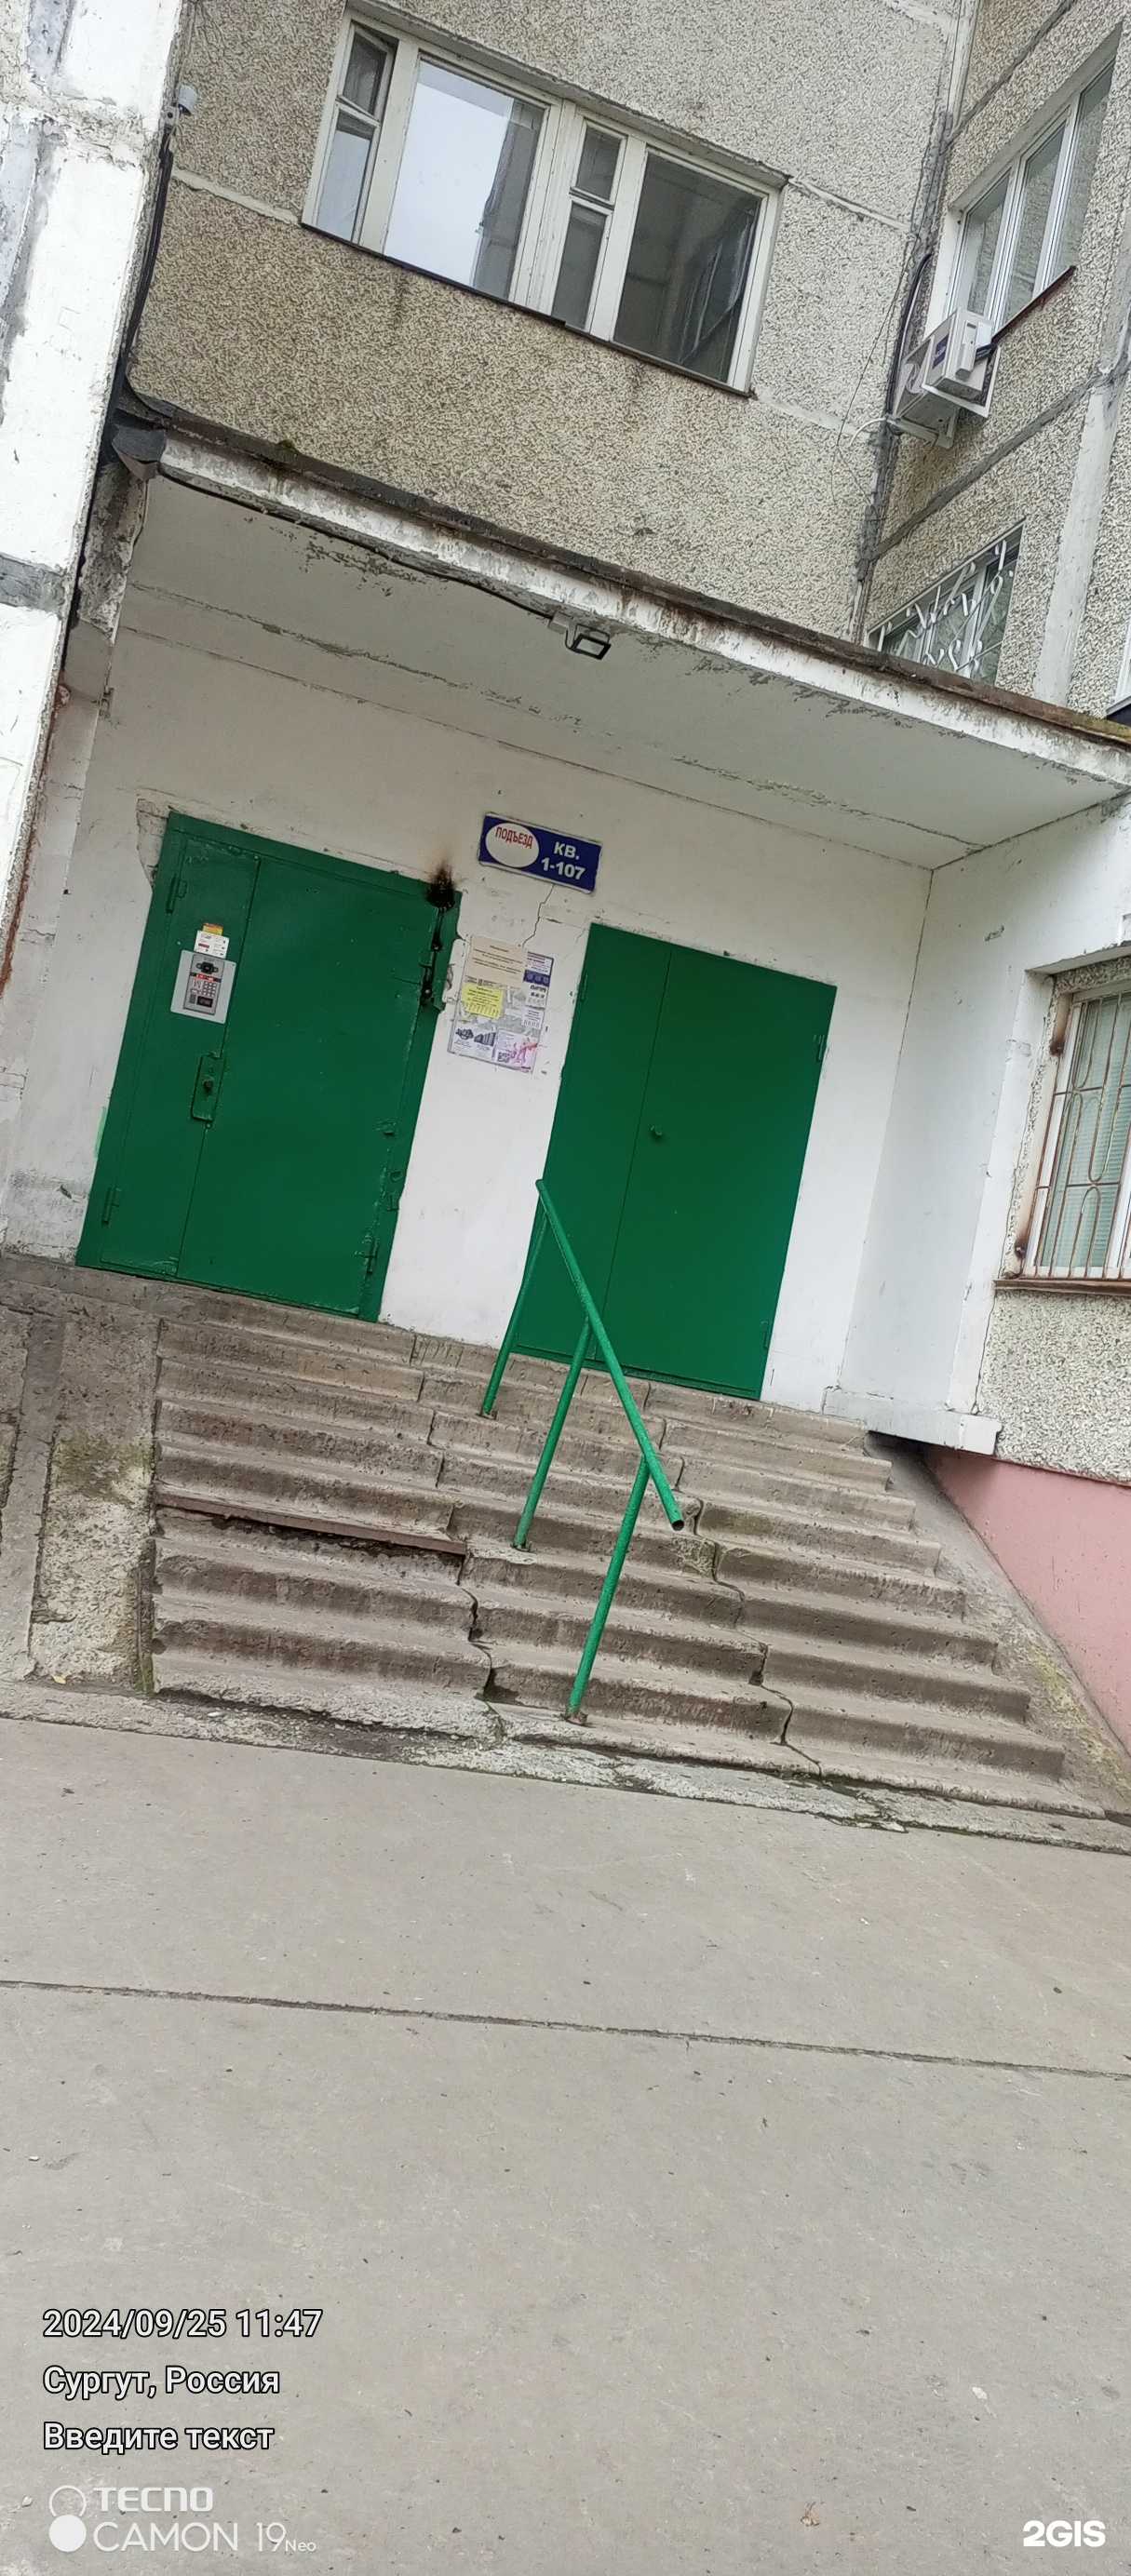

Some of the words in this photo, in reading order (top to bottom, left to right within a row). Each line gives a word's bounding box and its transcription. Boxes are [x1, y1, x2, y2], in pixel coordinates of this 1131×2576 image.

[495, 826, 533, 849] ПОДЪЕЗД
[553, 841, 580, 860] КВ.
[541, 857, 586, 880] 1-107
